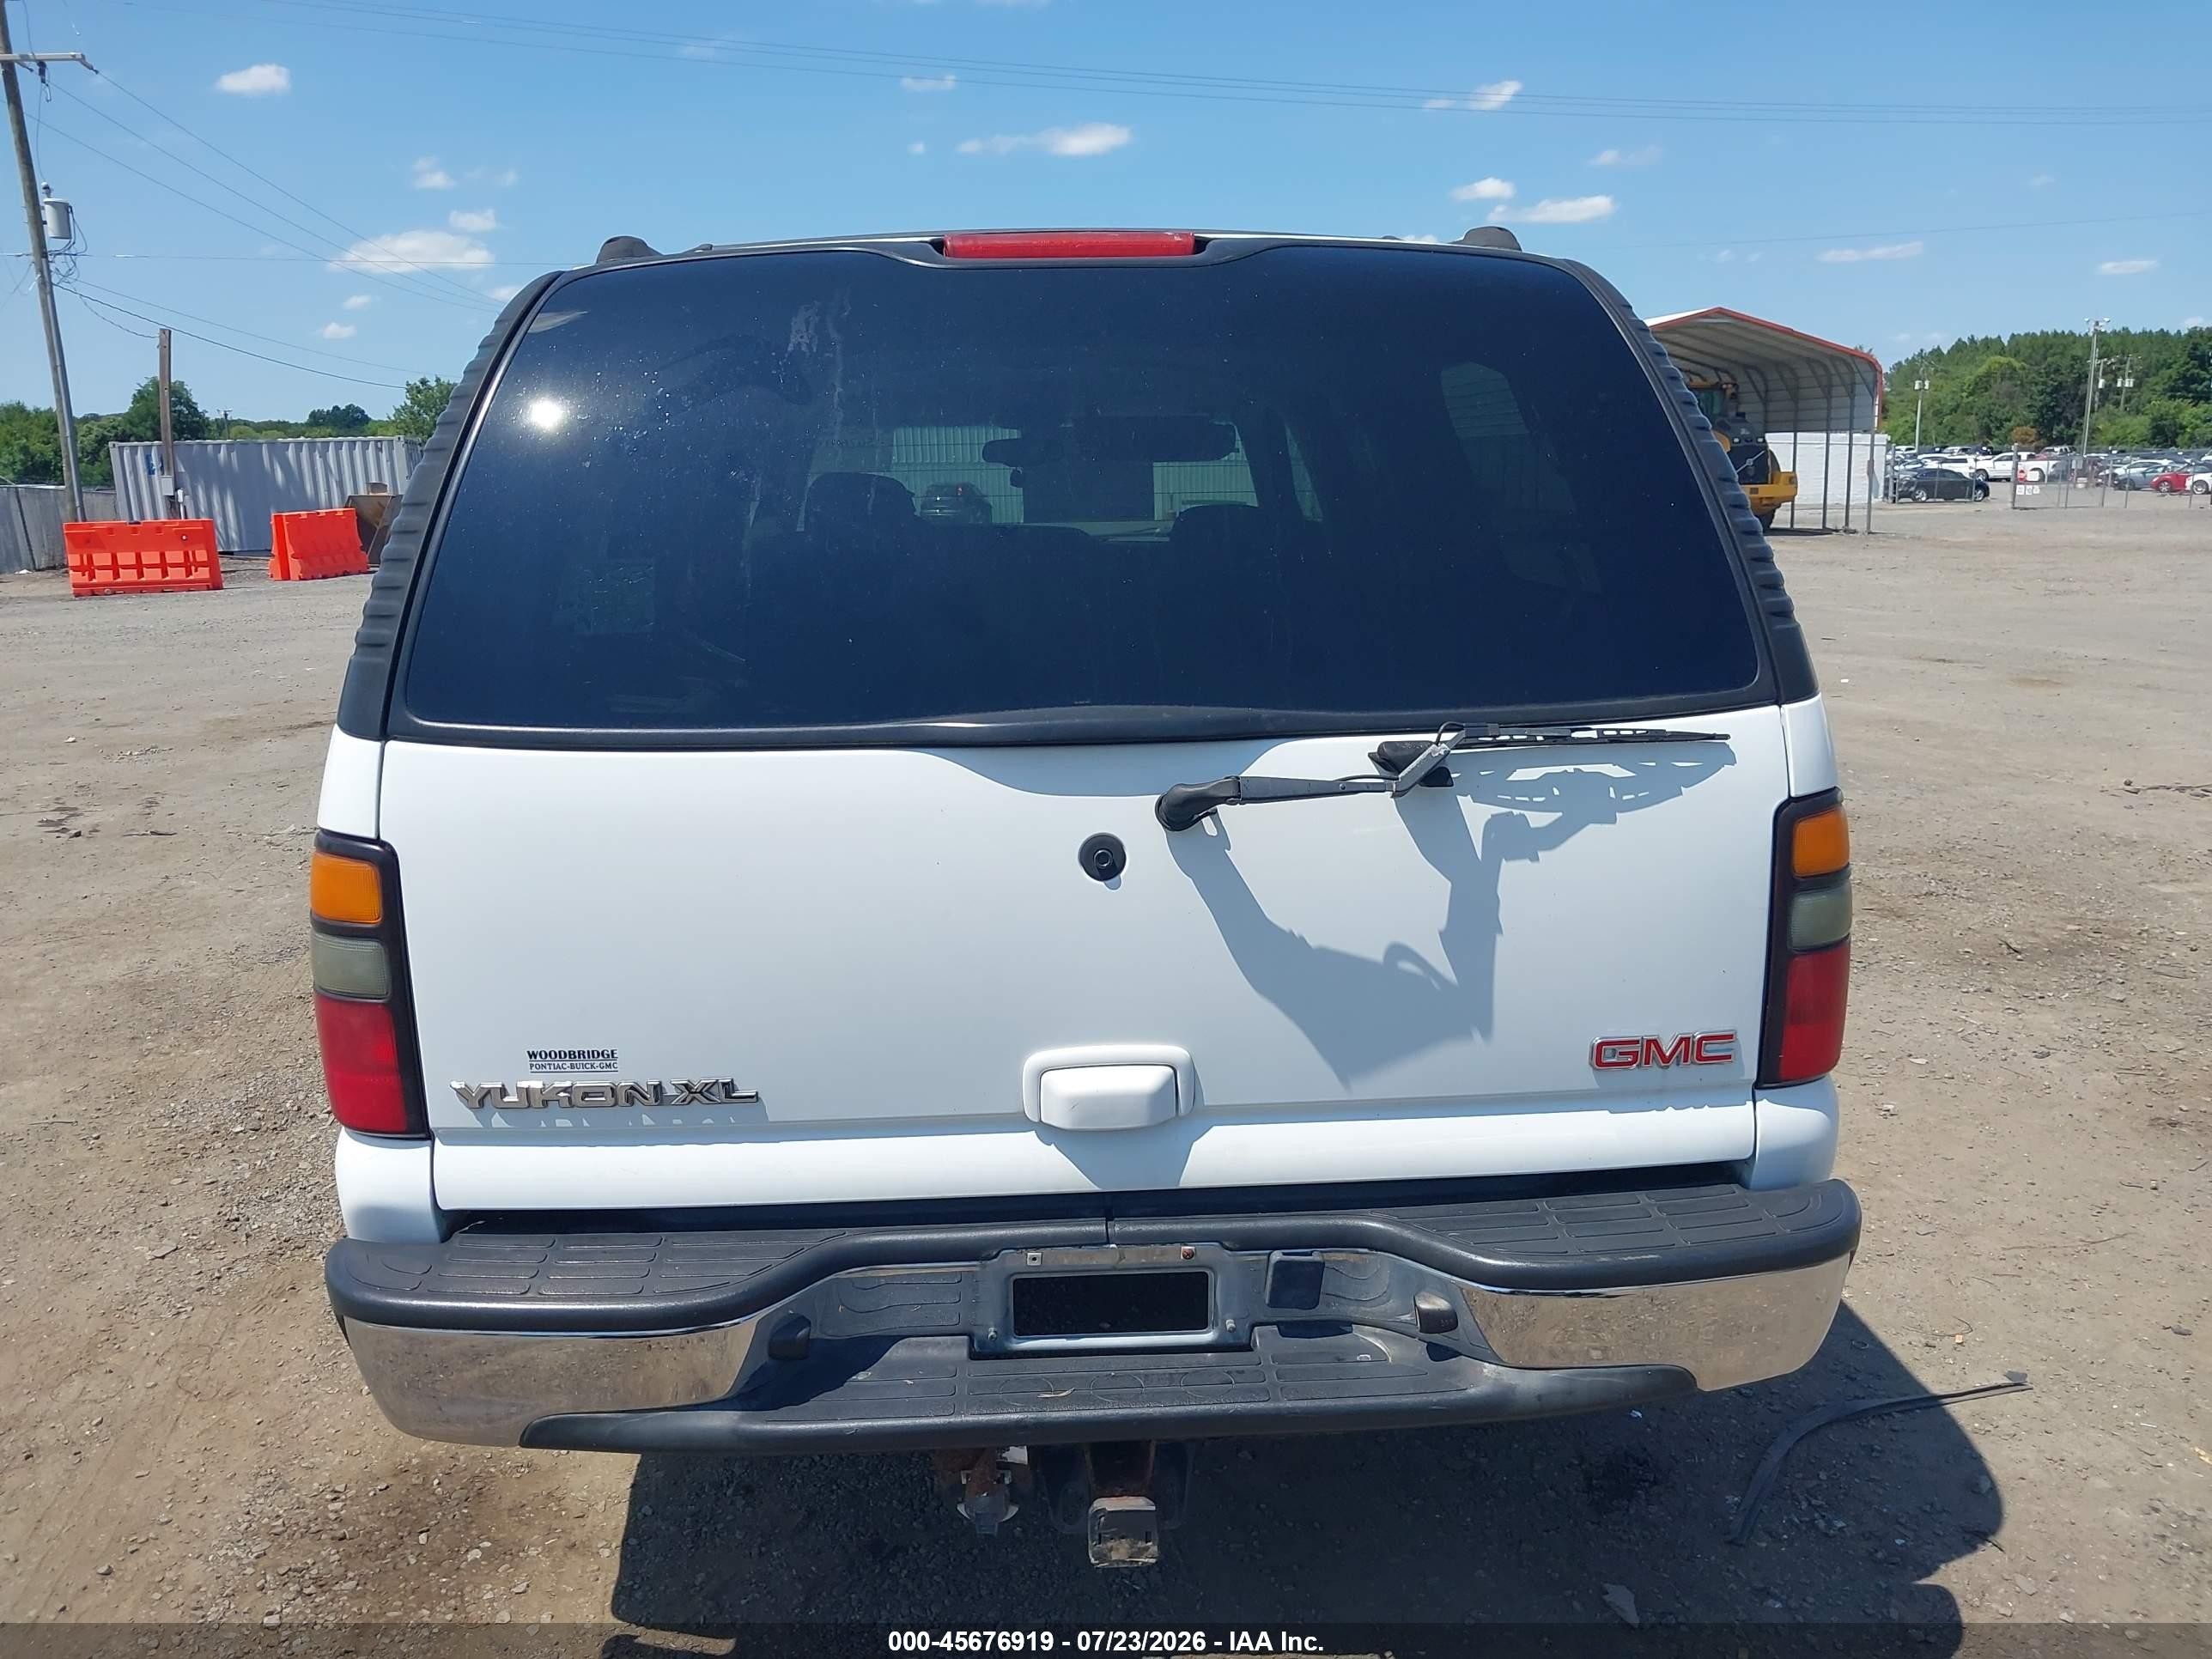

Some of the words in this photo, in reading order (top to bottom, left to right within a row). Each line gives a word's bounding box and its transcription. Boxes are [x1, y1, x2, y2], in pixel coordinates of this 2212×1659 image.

[526, 1048, 618, 1060] WOODBRIDGE
[1591, 1030, 1736, 1070] GMC
[529, 1061, 618, 1070] PONTIAC-BUICK-GMC
[450, 1079, 661, 1109] YUKON
[670, 1077, 757, 1106] XL
